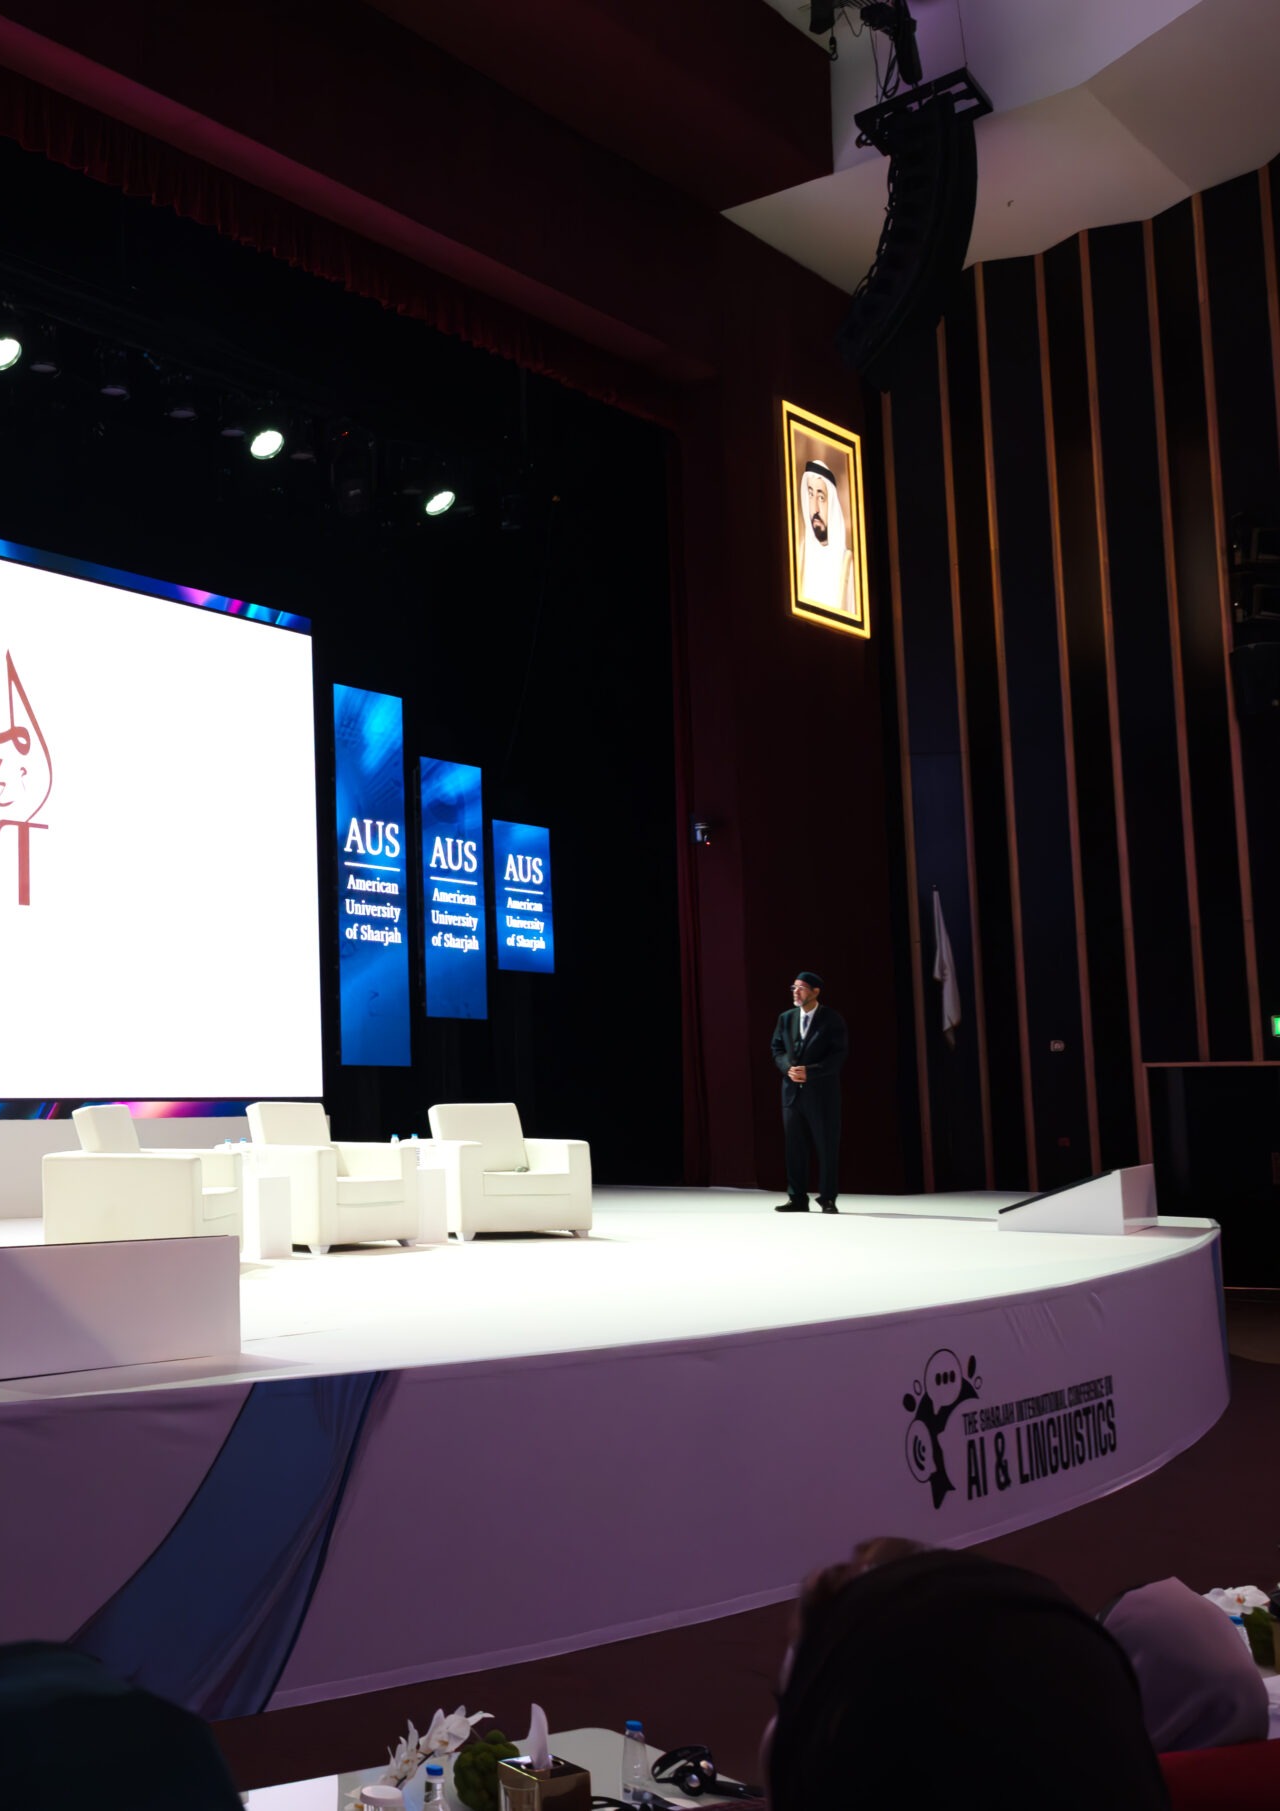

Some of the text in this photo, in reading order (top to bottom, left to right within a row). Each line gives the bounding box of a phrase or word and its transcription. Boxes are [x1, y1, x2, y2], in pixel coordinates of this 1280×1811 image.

[344, 817, 400, 858] AUS
[430, 836, 478, 872] AUS
[504, 854, 544, 884] AUS
[346, 874, 399, 894] American
[432, 888, 476, 906] American
[507, 897, 543, 912] American
[345, 898, 401, 922] University
[432, 910, 478, 930] University
[346, 923, 402, 946] of Sharjah
[506, 916, 544, 933] University
[432, 932, 480, 952] of Sharjah
[506, 934, 546, 950] of Sharjah
[962, 1412, 979, 1436] THE
[980, 1402, 1014, 1432] SHARJAH
[1016, 1389, 1067, 1422] INTERNATIONAL
[1068, 1378, 1104, 1407] CONFERENCE
[967, 1399, 1117, 1500] AI & LINGUISTICS
